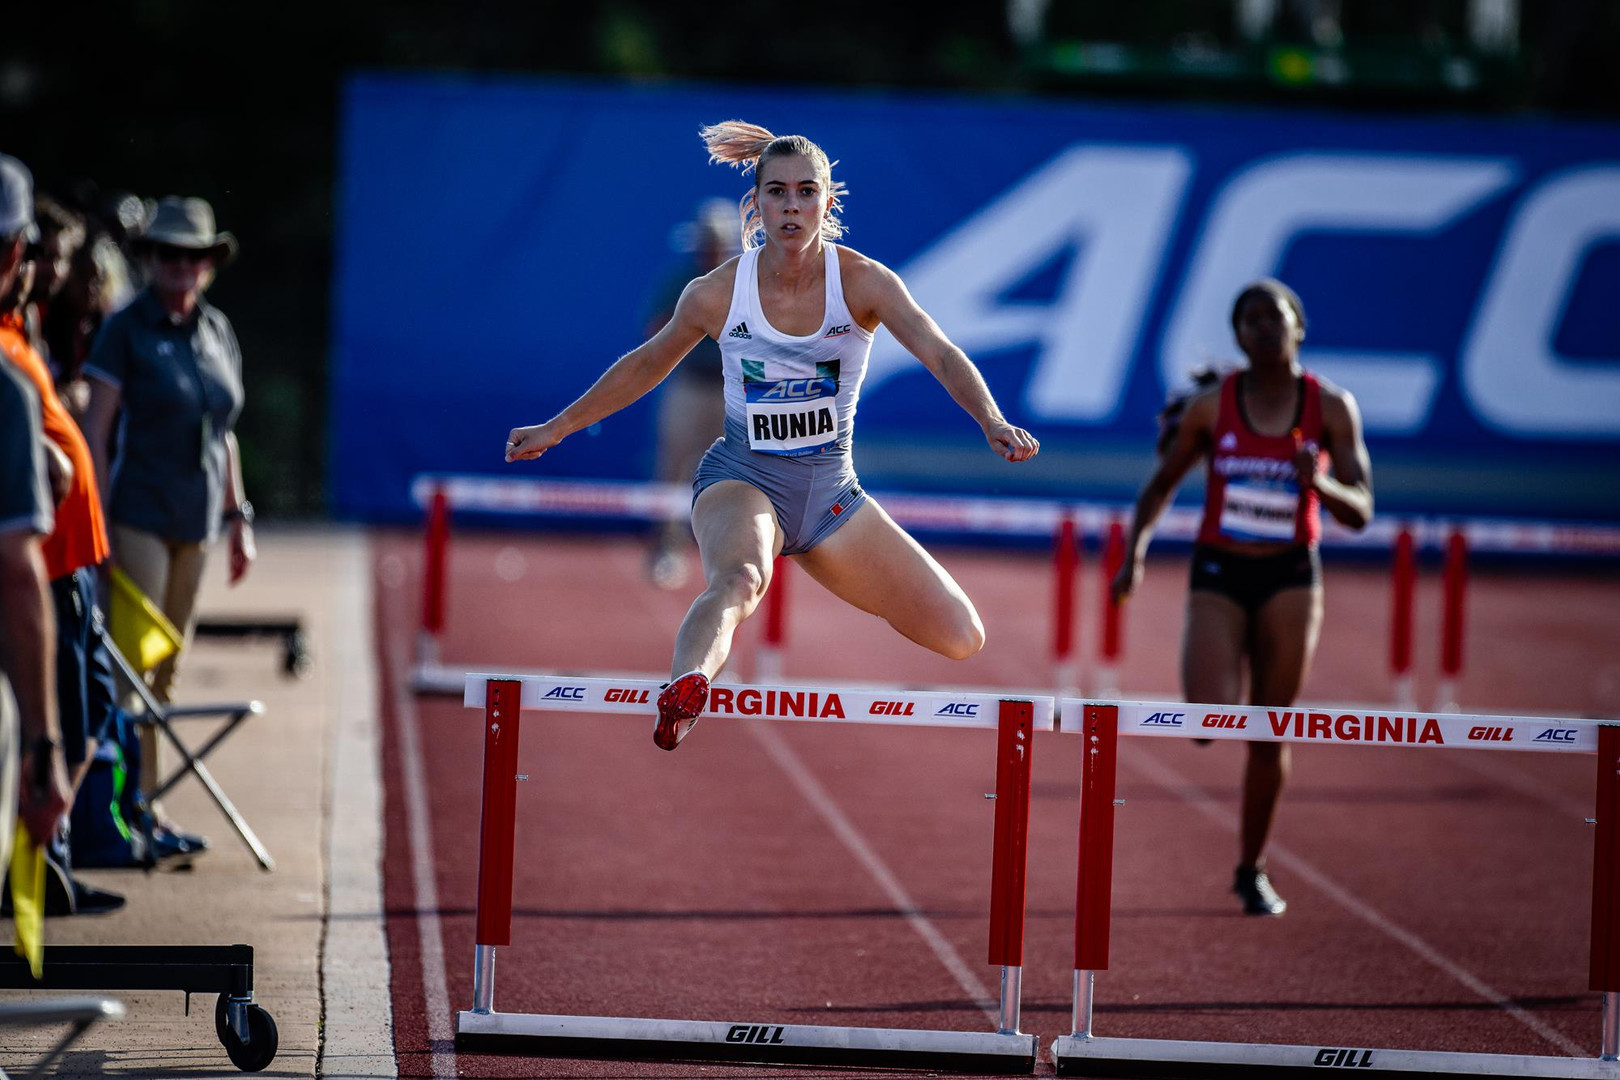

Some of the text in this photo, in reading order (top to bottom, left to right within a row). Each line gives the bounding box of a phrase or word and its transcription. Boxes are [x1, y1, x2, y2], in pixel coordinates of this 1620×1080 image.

[728, 331, 752, 340] adidas
[826, 324, 851, 336] ACC
[762, 379, 824, 398] ACC
[753, 407, 834, 441] RUNIA
[545, 686, 980, 719] ACC GILL RGINIA GILL ACC
[1143, 711, 1578, 744] ACC GILL VIRGINIA GILL ACC
[725, 1025, 785, 1044] GILL
[1313, 1049, 1374, 1068] GILL
